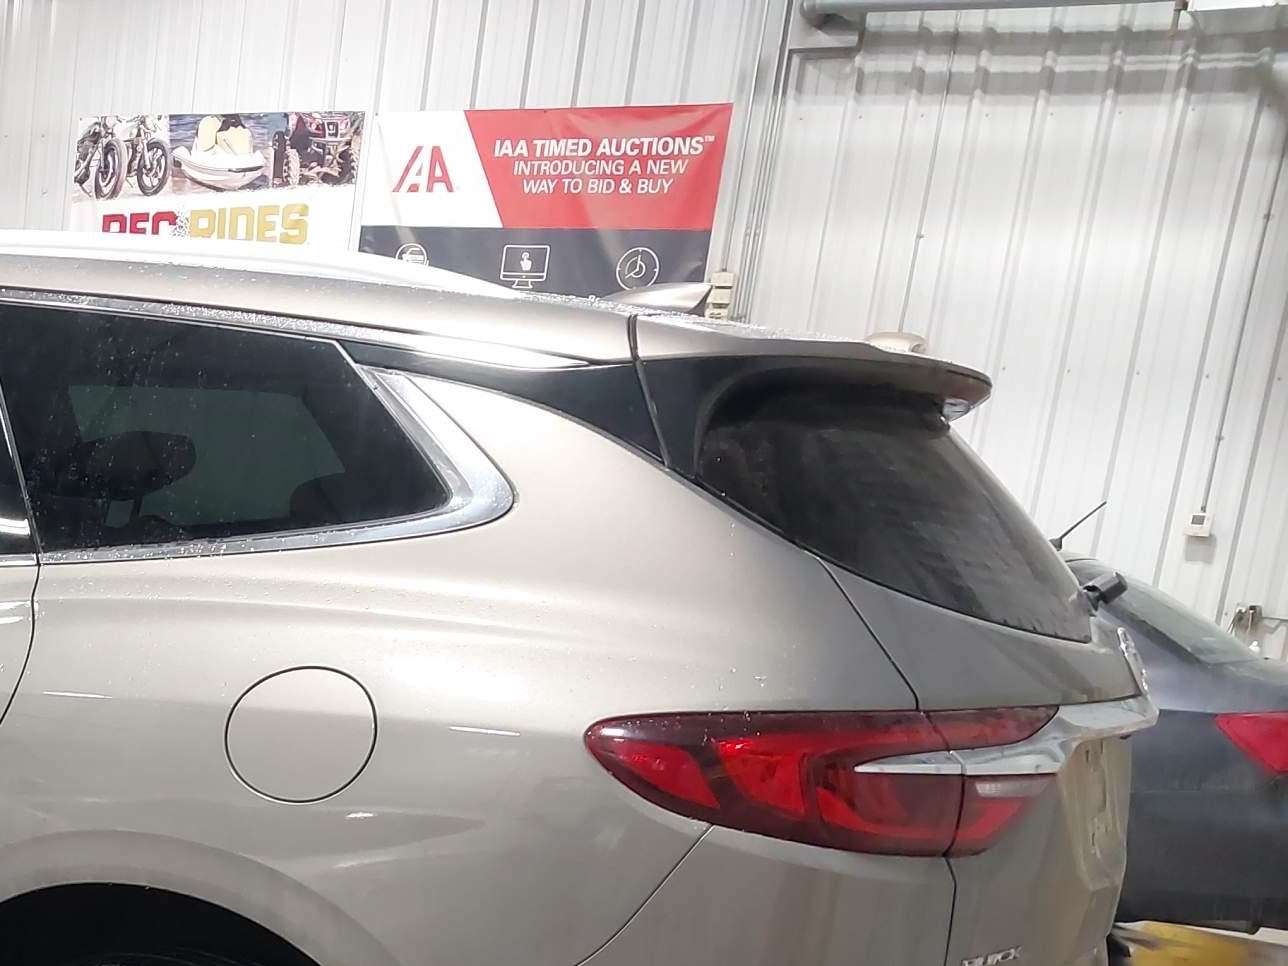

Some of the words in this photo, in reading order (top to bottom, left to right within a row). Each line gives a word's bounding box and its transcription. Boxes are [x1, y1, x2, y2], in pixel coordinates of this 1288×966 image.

[494, 139, 529, 157] IAA
[534, 138, 592, 157] TIMED
[513, 159, 624, 176] INTRODUCING
[628, 160, 642, 175] A
[646, 159, 689, 175] NEW
[522, 179, 558, 194] WAY
[562, 179, 583, 194] TO
[587, 179, 615, 194] BID
[618, 179, 633, 194] &
[637, 178, 674, 194] BUY
